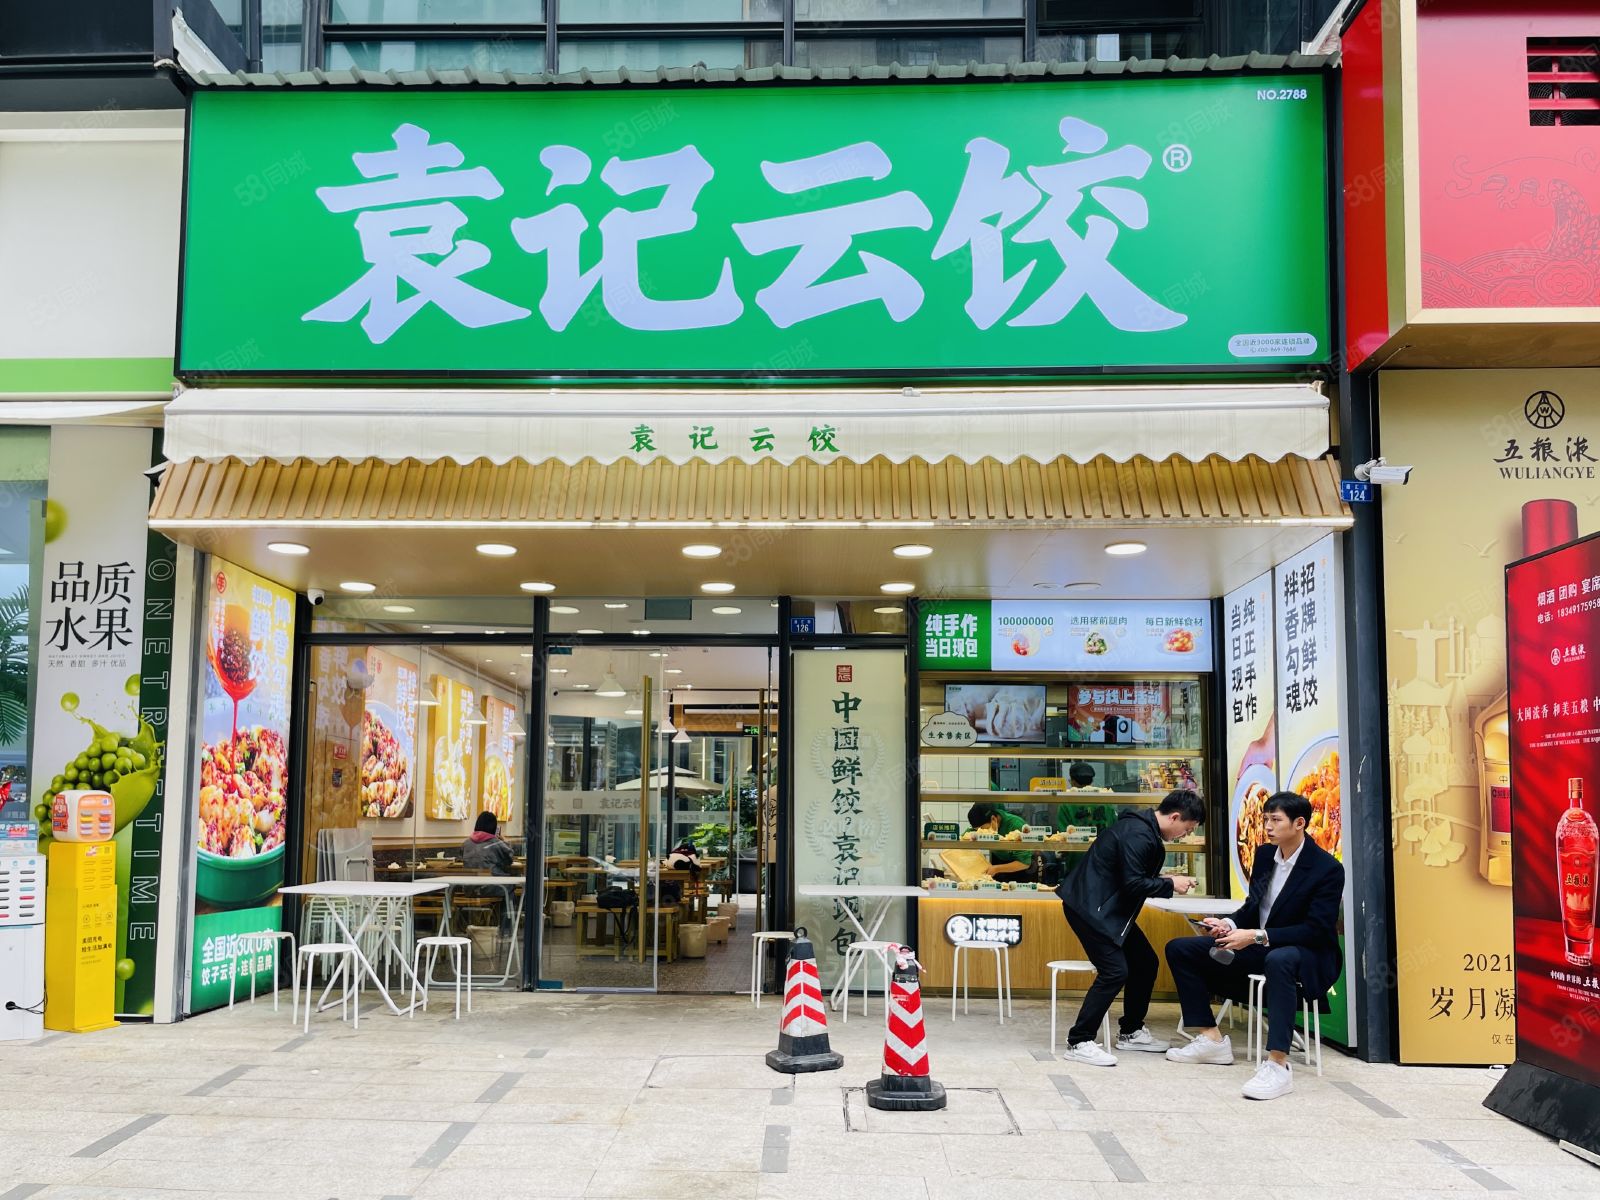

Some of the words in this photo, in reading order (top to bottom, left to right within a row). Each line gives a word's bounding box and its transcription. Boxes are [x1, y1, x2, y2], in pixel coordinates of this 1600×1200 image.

[1257, 88, 1307, 101] NO.2788
[302, 122, 1188, 345] 袁记云饺
[629, 423, 841, 453] 袁记云饺
[1493, 436, 1599, 463] 五粮液
[1499, 467, 1596, 480] WULIANGYE
[1349, 490, 1366, 501] 124
[51, 561, 136, 605] 品质
[1537, 589, 1555, 607] 烟酒
[1558, 582, 1578, 601] 团购
[1557, 597, 1600, 618] 18349175958
[44, 606, 133, 651] 水果
[796, 623, 809, 633] 126
[925, 613, 978, 638] 纯手作
[998, 616, 1054, 626] 100000000
[1070, 616, 1128, 626] 选用猪前腿肉
[1145, 617, 1205, 627] 每日新鲜食材
[1283, 568, 1301, 714] 拌香勾魂
[1300, 560, 1319, 709] 招牌鲜饺
[925, 638, 978, 658] 当日现包
[1243, 596, 1258, 722] 纯正手作
[1231, 603, 1245, 724] 当日现包
[1463, 953, 1513, 972] 2021
